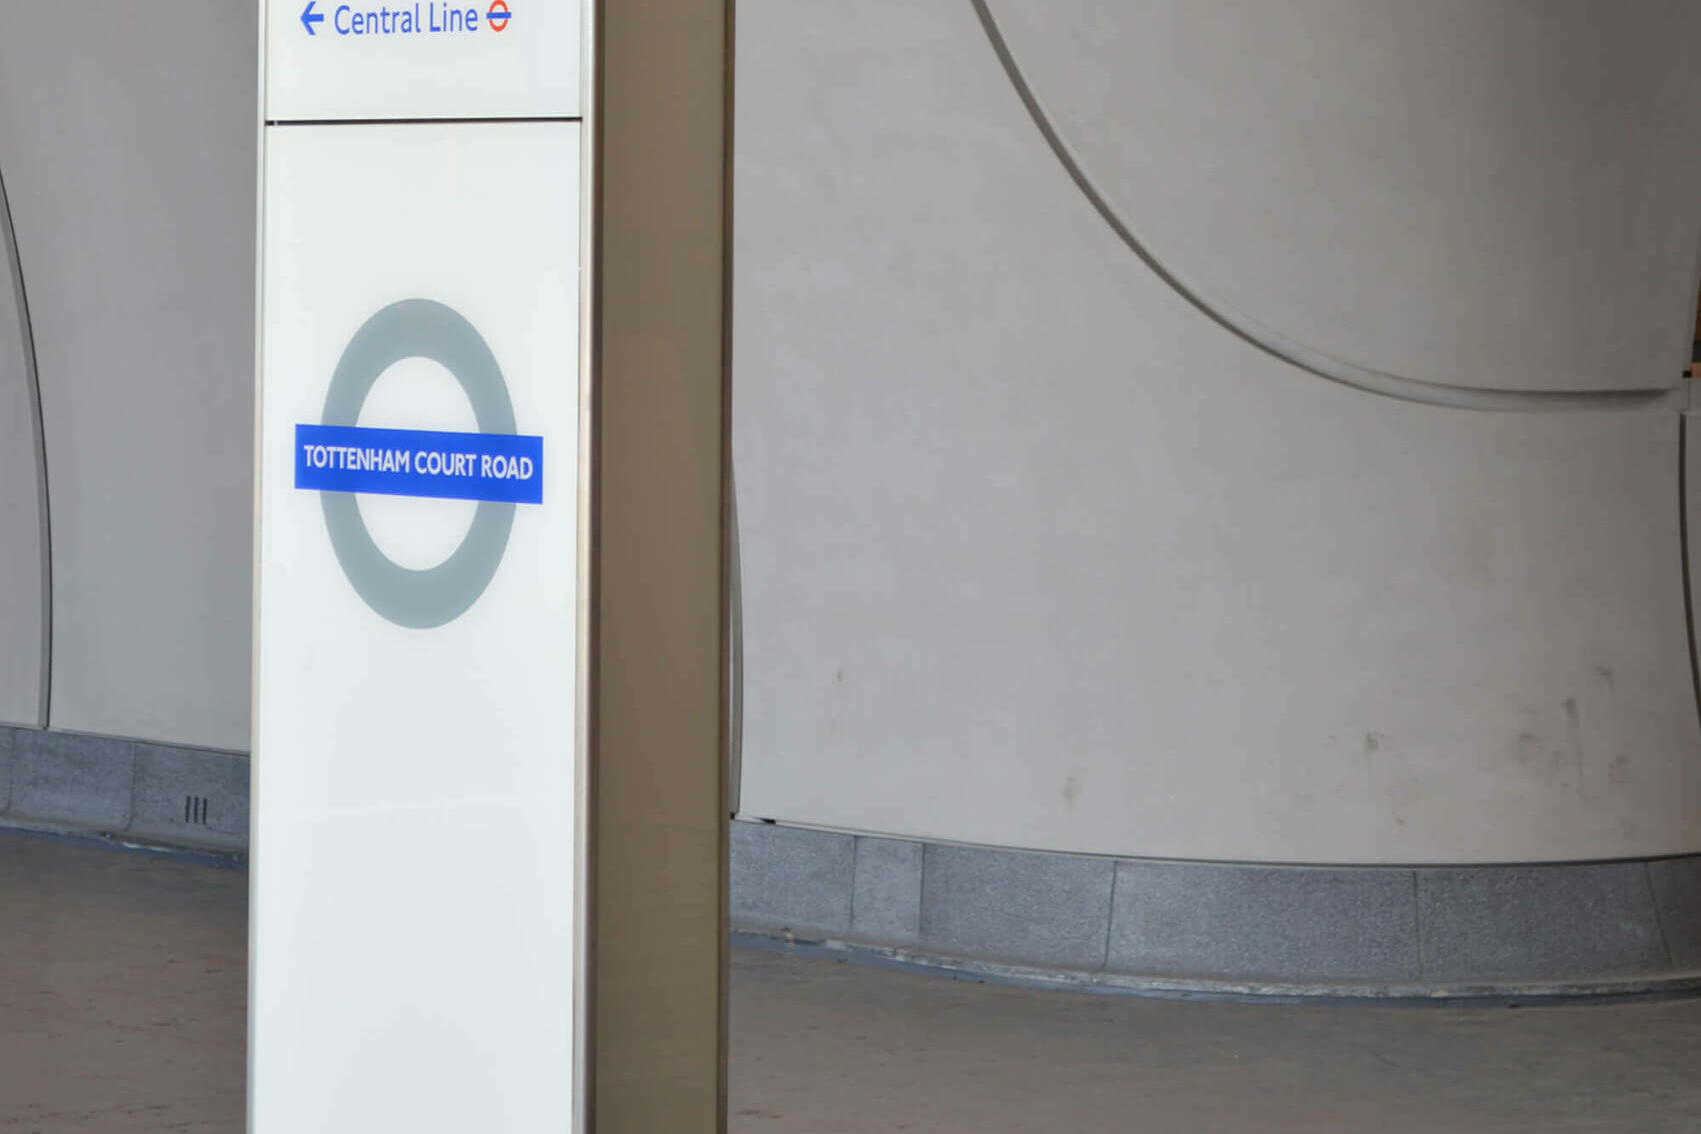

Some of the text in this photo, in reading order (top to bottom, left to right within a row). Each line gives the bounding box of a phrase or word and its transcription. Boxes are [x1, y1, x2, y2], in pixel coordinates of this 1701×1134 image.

[334, 2, 478, 35] Central Line
[304, 445, 534, 480] TOTTENHAM COURT ROAD
